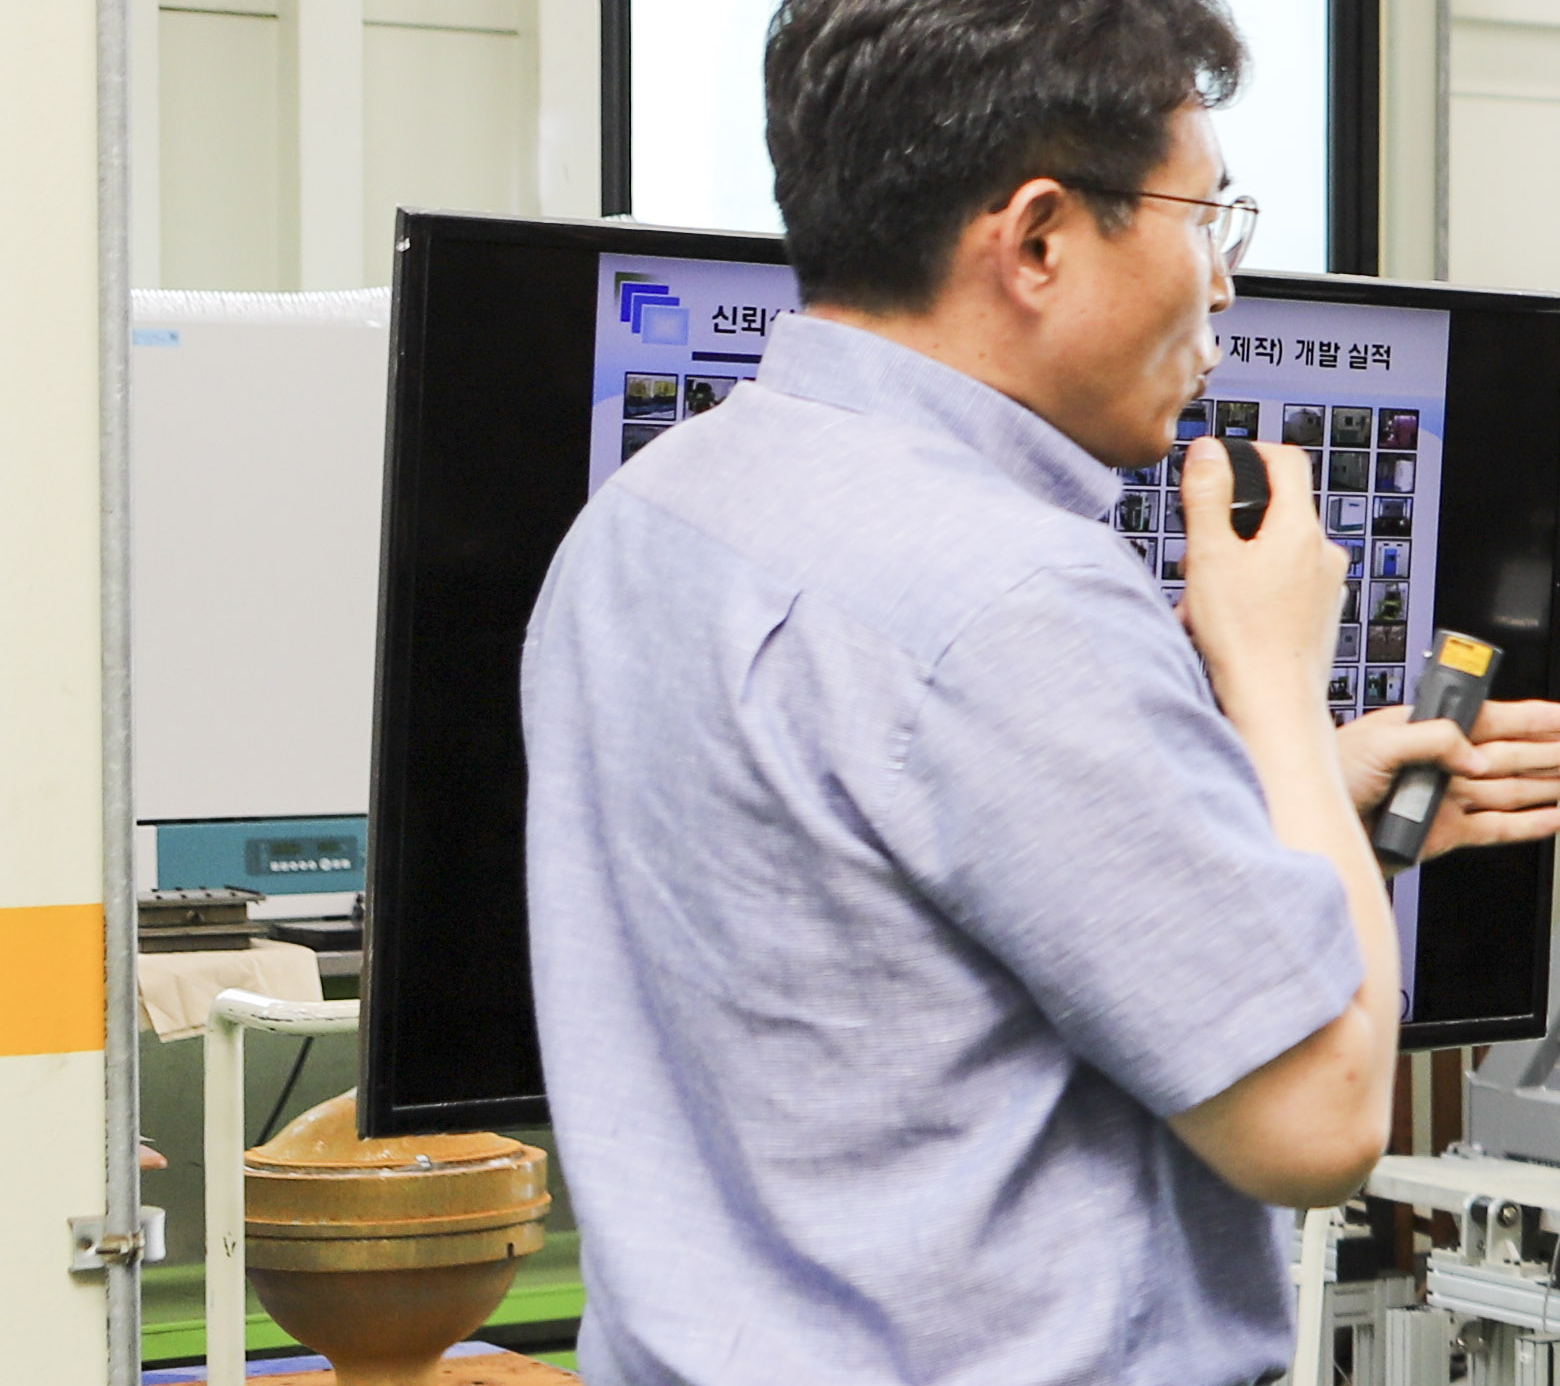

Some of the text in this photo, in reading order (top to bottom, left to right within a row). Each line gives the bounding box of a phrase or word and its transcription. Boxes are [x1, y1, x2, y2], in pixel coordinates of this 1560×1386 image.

[711, 305, 795, 336] 신뢰
[1230, 335, 1284, 366] 제작)
[1295, 339, 1341, 369] 개발
[1348, 343, 1392, 371] 실적
